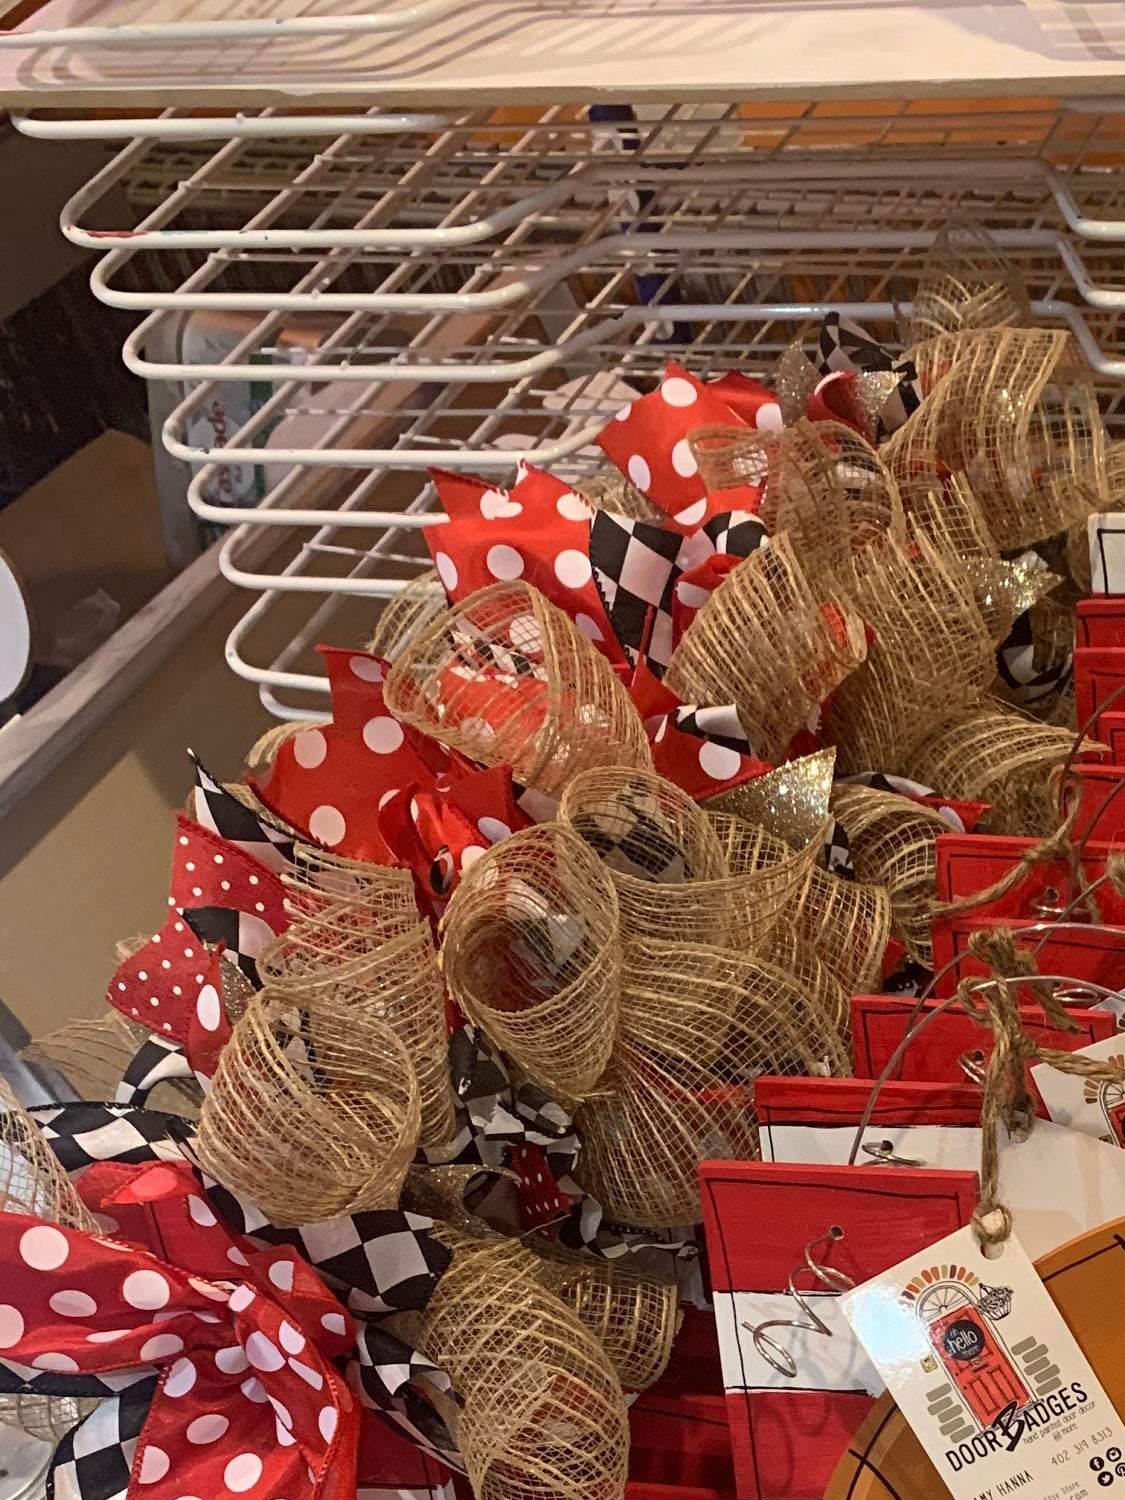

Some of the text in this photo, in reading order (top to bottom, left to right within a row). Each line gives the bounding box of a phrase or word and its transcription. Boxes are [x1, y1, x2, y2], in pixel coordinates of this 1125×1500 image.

[946, 1330, 978, 1354] hello
[1051, 1426, 1114, 1466] 402 319 8313
[996, 1470, 1034, 1497] HANNA
